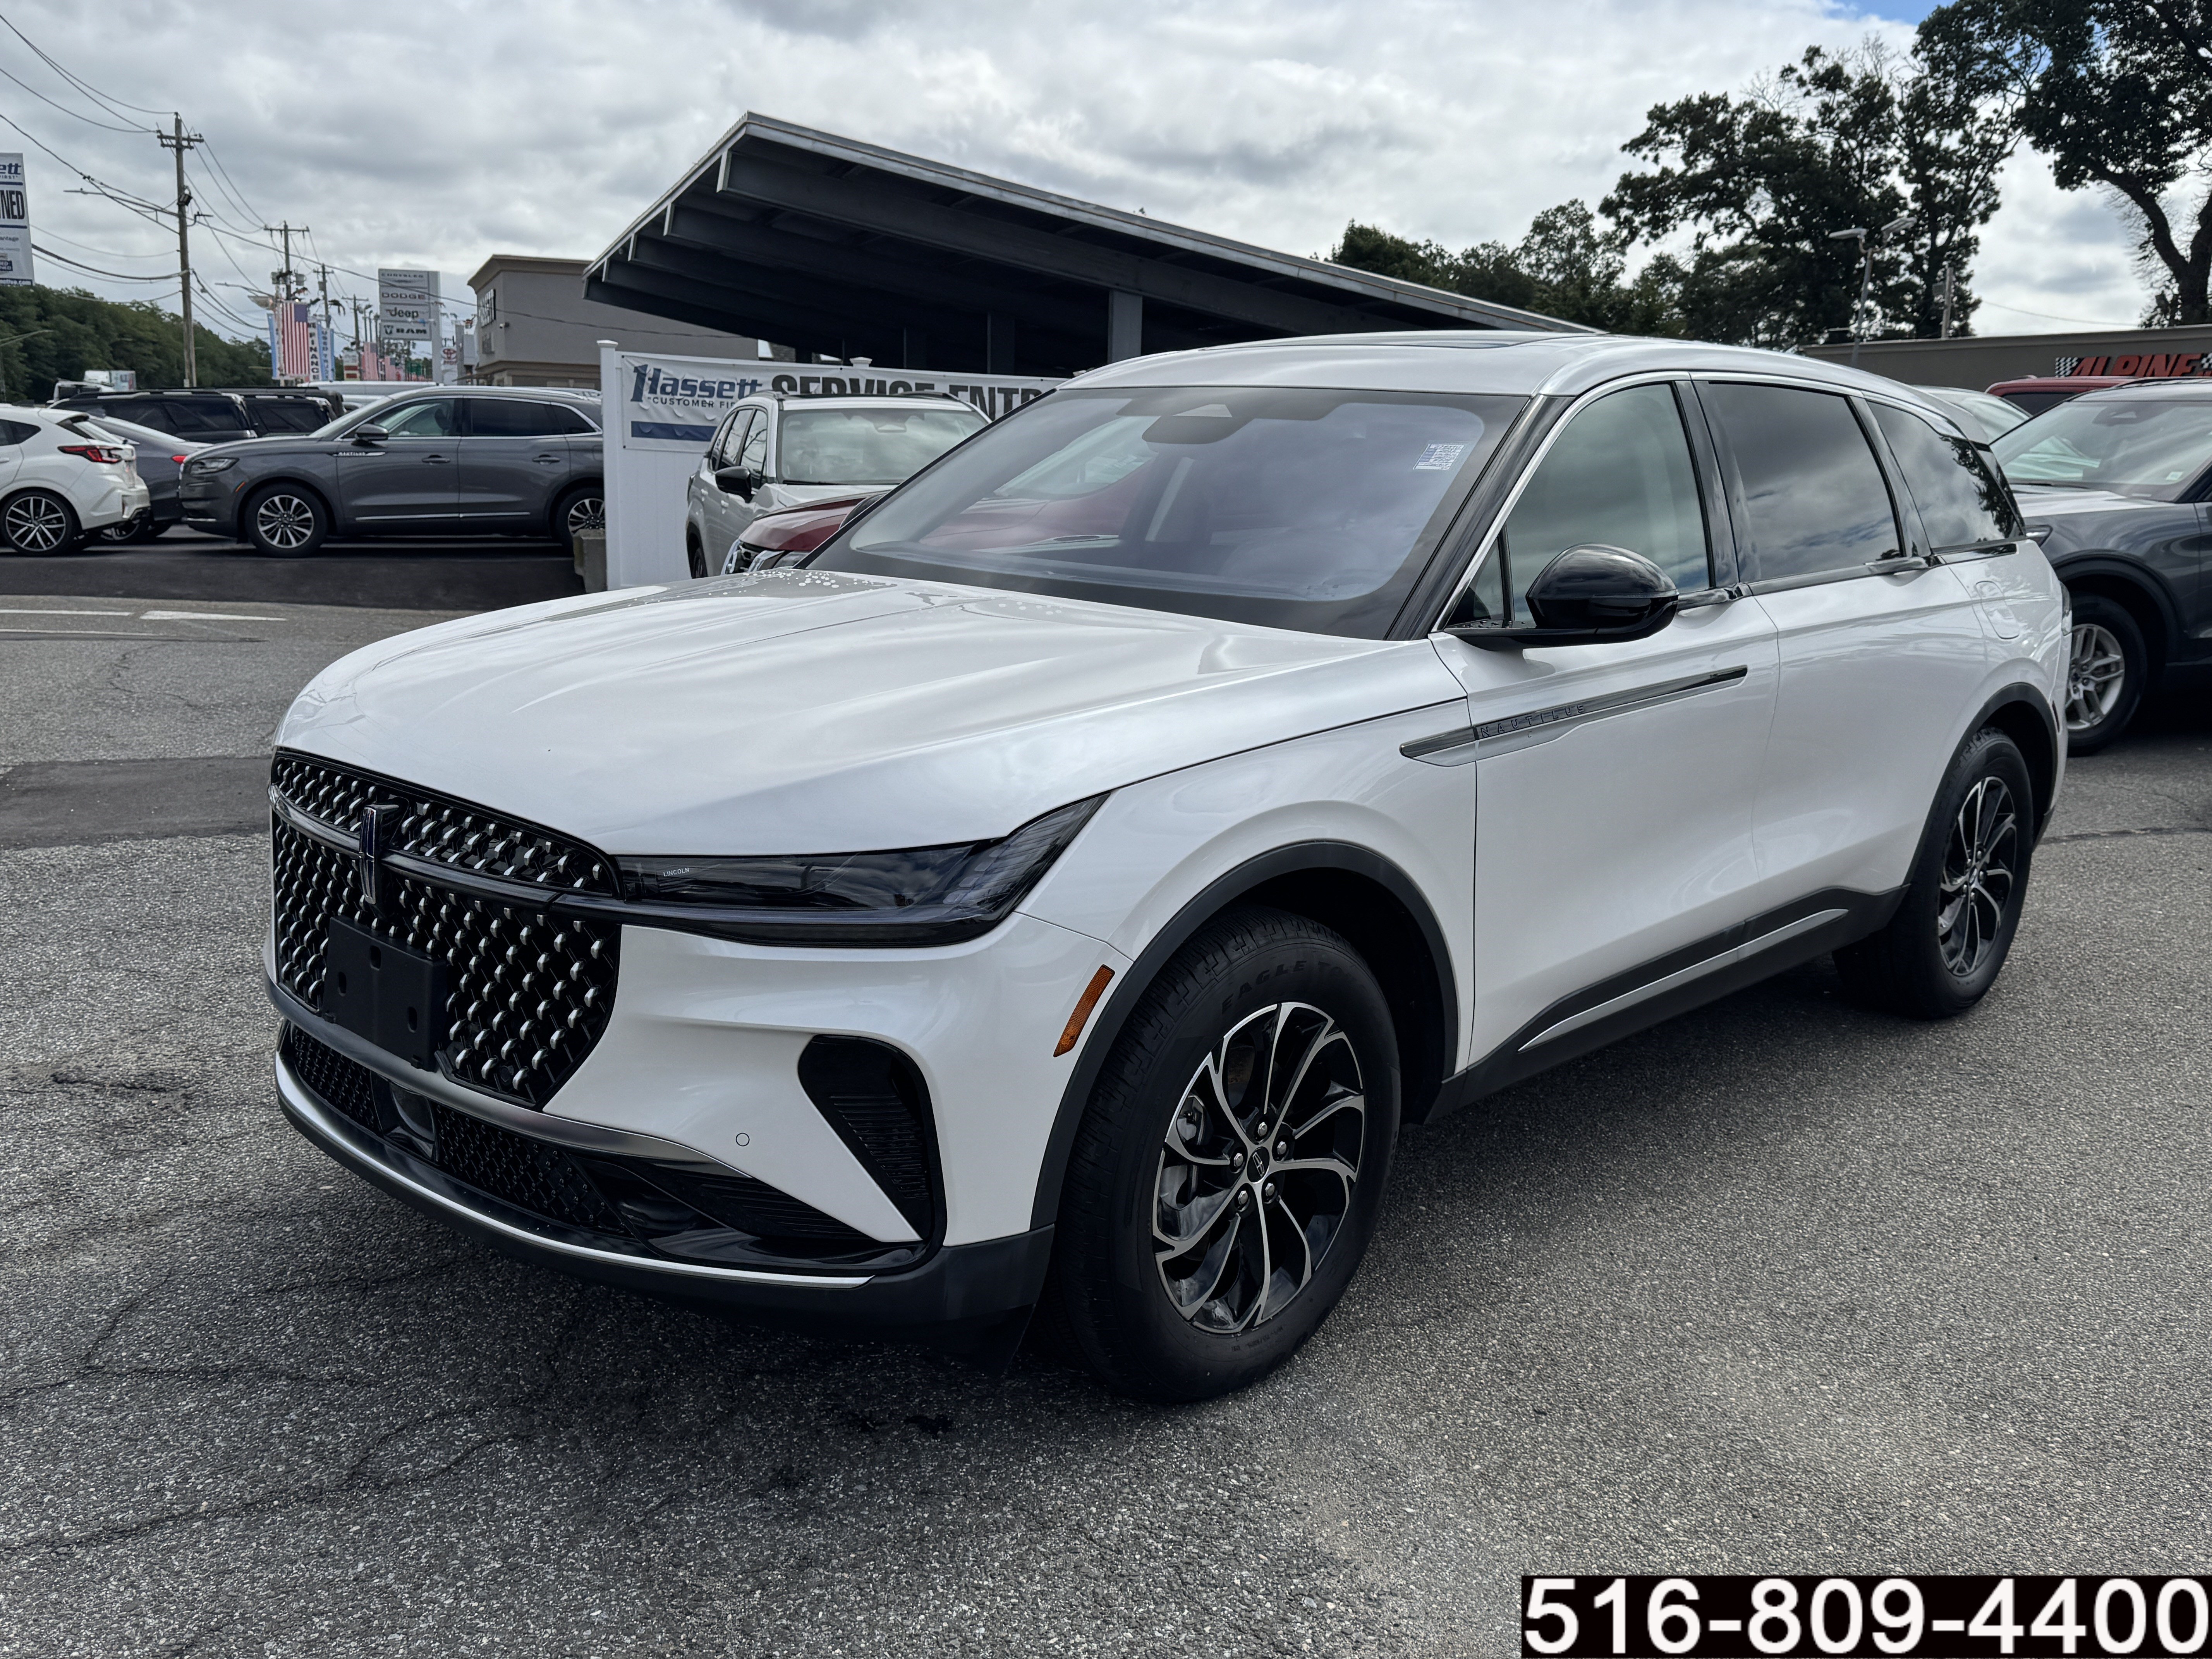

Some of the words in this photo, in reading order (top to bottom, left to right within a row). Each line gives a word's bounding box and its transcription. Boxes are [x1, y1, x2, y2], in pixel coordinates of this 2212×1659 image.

[0, 190, 25, 220] NED
[389, 307, 419, 318] Jeep
[1480, 704, 1585, 737] NAUTILUS
[663, 867, 689, 877] LINCOLN
[1222, 960, 1307, 1014] EAGLE
